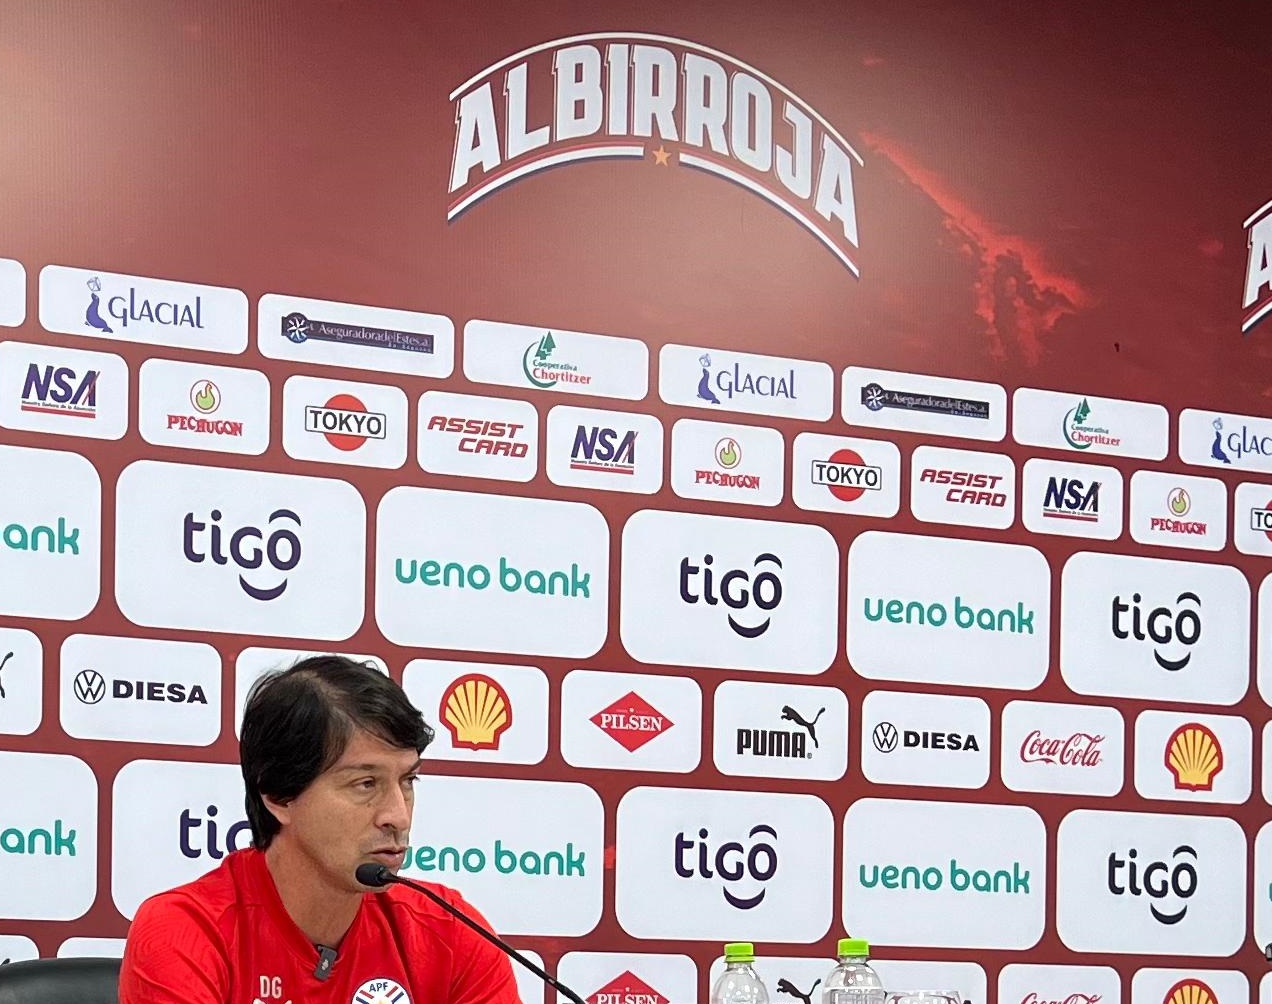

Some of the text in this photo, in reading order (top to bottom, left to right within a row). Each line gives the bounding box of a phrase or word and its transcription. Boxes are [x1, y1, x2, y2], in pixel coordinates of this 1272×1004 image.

[448, 43, 859, 249] ALBIRROJA
[108, 287, 204, 329] GLACIAL
[21, 363, 99, 406] NSA
[532, 368, 592, 384] Chortitzer
[716, 363, 797, 401] GLACIAL
[166, 415, 243, 436] PECHUGON
[310, 411, 382, 436] TOKYO
[428, 417, 524, 437] ASSIST
[459, 438, 529, 458] CARD
[571, 425, 637, 464] NSA
[1227, 425, 1272, 459] GLAC
[695, 470, 760, 489] PECHUGON
[815, 464, 878, 488] TOKYO
[921, 469, 1003, 488] ASSIST
[947, 488, 1006, 507] CARD
[1043, 477, 1101, 512] NSA
[395, 556, 590, 598] ueno bank
[864, 598, 1034, 633] ueno bank
[113, 680, 207, 704] DIESA
[600, 713, 663, 732] PILSEN
[737, 729, 805, 758] PUMA
[904, 731, 979, 752] DIESA
[1019, 730, 1102, 768] Coca-Cola
[494, 840, 585, 876] bank
[859, 859, 1030, 894] ueno bank
[259, 975, 282, 998] DG
[369, 981, 388, 992] APF
